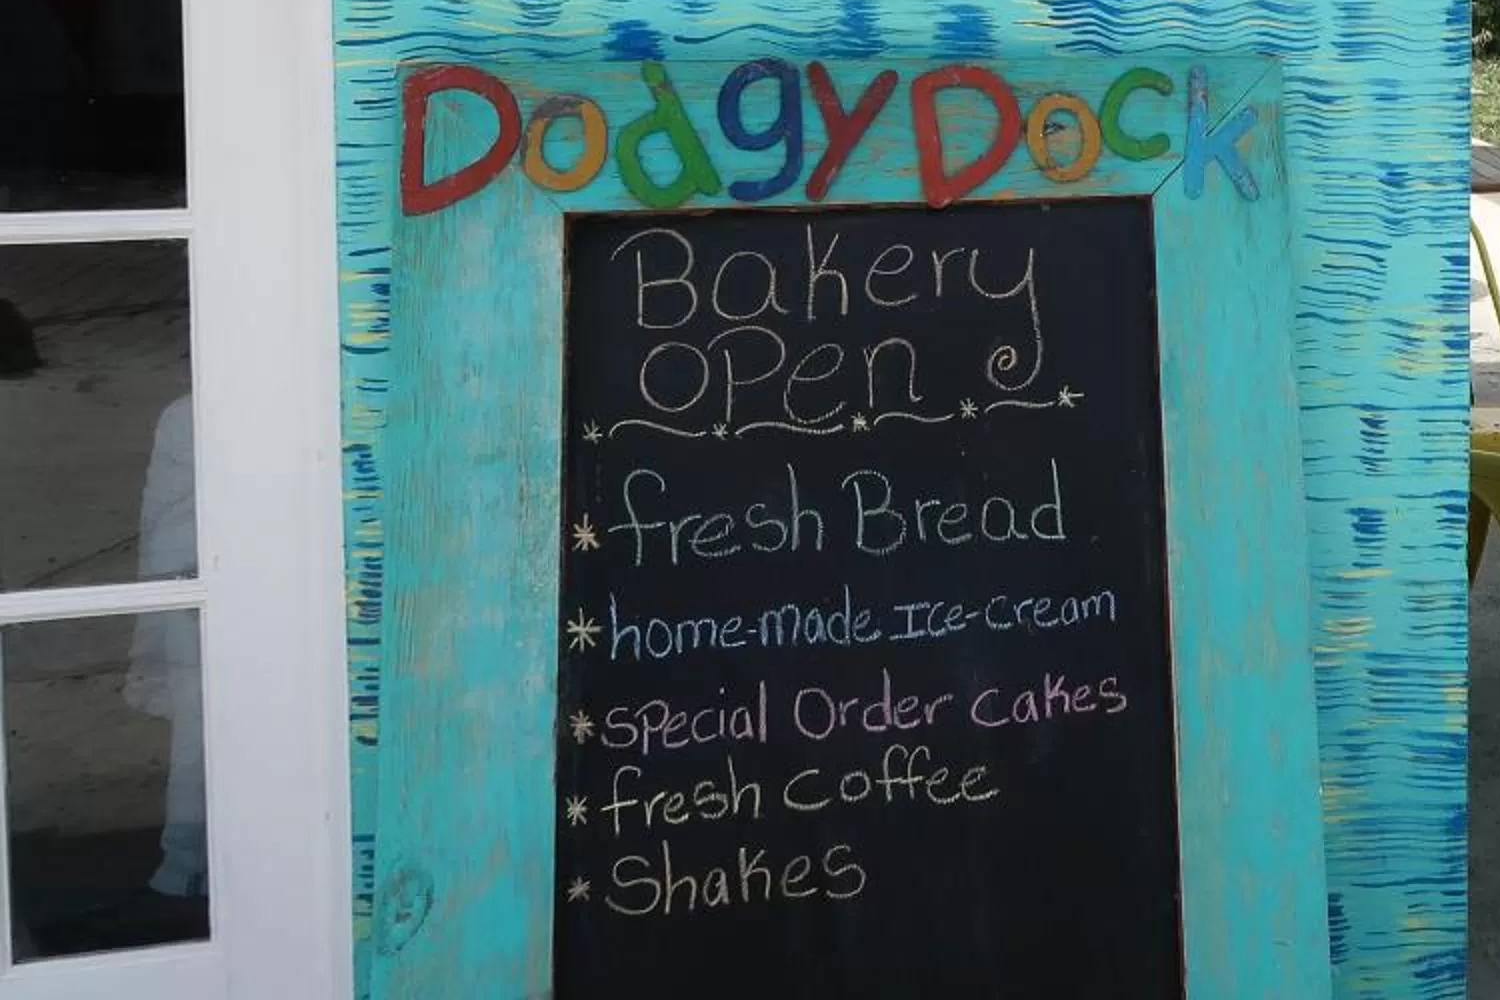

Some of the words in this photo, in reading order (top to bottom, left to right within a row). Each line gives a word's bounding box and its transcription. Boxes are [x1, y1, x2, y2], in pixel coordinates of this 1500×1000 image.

[610, 223, 1044, 392] Bakery
[607, 463, 825, 567] fresh
[841, 457, 1070, 556] Bread
[793, 667, 955, 740] Order
[601, 755, 761, 838] fresh
[604, 839, 868, 917] Shakes
